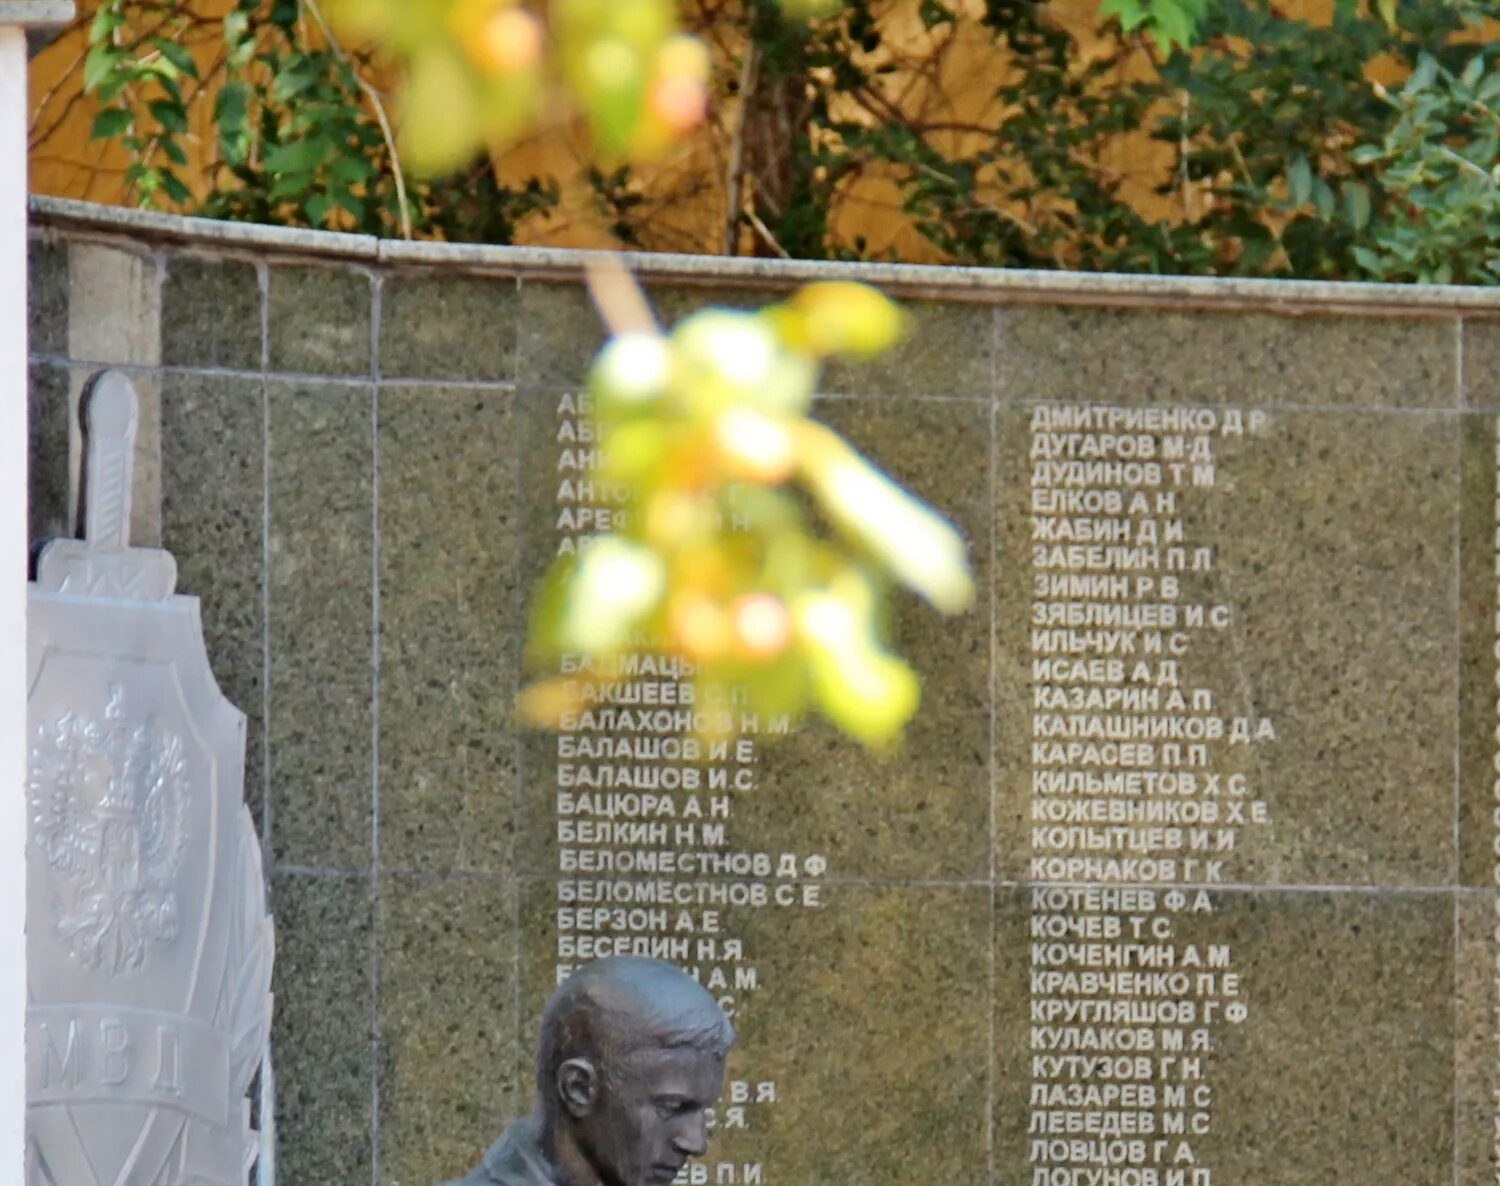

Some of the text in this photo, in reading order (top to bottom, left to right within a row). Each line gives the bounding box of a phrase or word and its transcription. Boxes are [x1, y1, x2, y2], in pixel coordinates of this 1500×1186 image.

[1031, 405, 1216, 432] ДМИТРИЕНКО
[1031, 434, 1155, 459] ДУГАРОВ
[1031, 461, 1161, 487] ДУДИНОВ
[1032, 489, 1121, 513] ЕЛКОВ
[1032, 518, 1130, 541] ЖАБИН
[1033, 545, 1159, 569] ЗАБЕЛИН
[1034, 574, 1128, 597] ЗИМИН
[1032, 603, 1177, 629] ЗЯБЛИЦЕВ
[1032, 630, 1137, 653] ИЛЬЧУК
[1033, 660, 1124, 681] ИСАЕВ
[1034, 687, 1159, 710] КАЗАРИН
[558, 737, 700, 760] БАЛАШОВ
[1032, 744, 1153, 765] КАРАСЕВ
[558, 764, 700, 789] БАЛАШОВ
[1032, 772, 1196, 794] КИЛЬМЕТОВ
[557, 792, 675, 819] БАЦЮРА
[1032, 800, 1218, 823] КОЖЕВНИКОВ
[558, 820, 666, 843] БЕЛКИН
[1032, 828, 1182, 852] КОПЫТЦЕВ
[560, 850, 770, 876] БЕЛОМЕСТНОВ
[1031, 857, 1176, 880] КОРНАКОВ
[558, 881, 766, 905] БЕЛОМЕСТНОВ
[1032, 889, 1155, 911] КОТЕНЕВ
[557, 909, 666, 930] БЕРЗОН
[1032, 916, 1120, 938] КОЧЕВ
[1032, 944, 1173, 967] КОЧЕНГИН
[1031, 972, 1189, 995] КРАВЧЕНКО
[1031, 1001, 1195, 1022] КРУГЛЯШОВ
[1031, 1028, 1153, 1050] КУЛАКОВ
[39, 1019, 182, 1096] МВД
[1032, 1056, 1151, 1078] КУТУЗОВ
[1029, 1085, 1155, 1106] ЛАЗАРЕВ
[1028, 1112, 1153, 1137] ЛЕБЕДЕВ
[1029, 1140, 1145, 1165] ЛОВЦОВ
